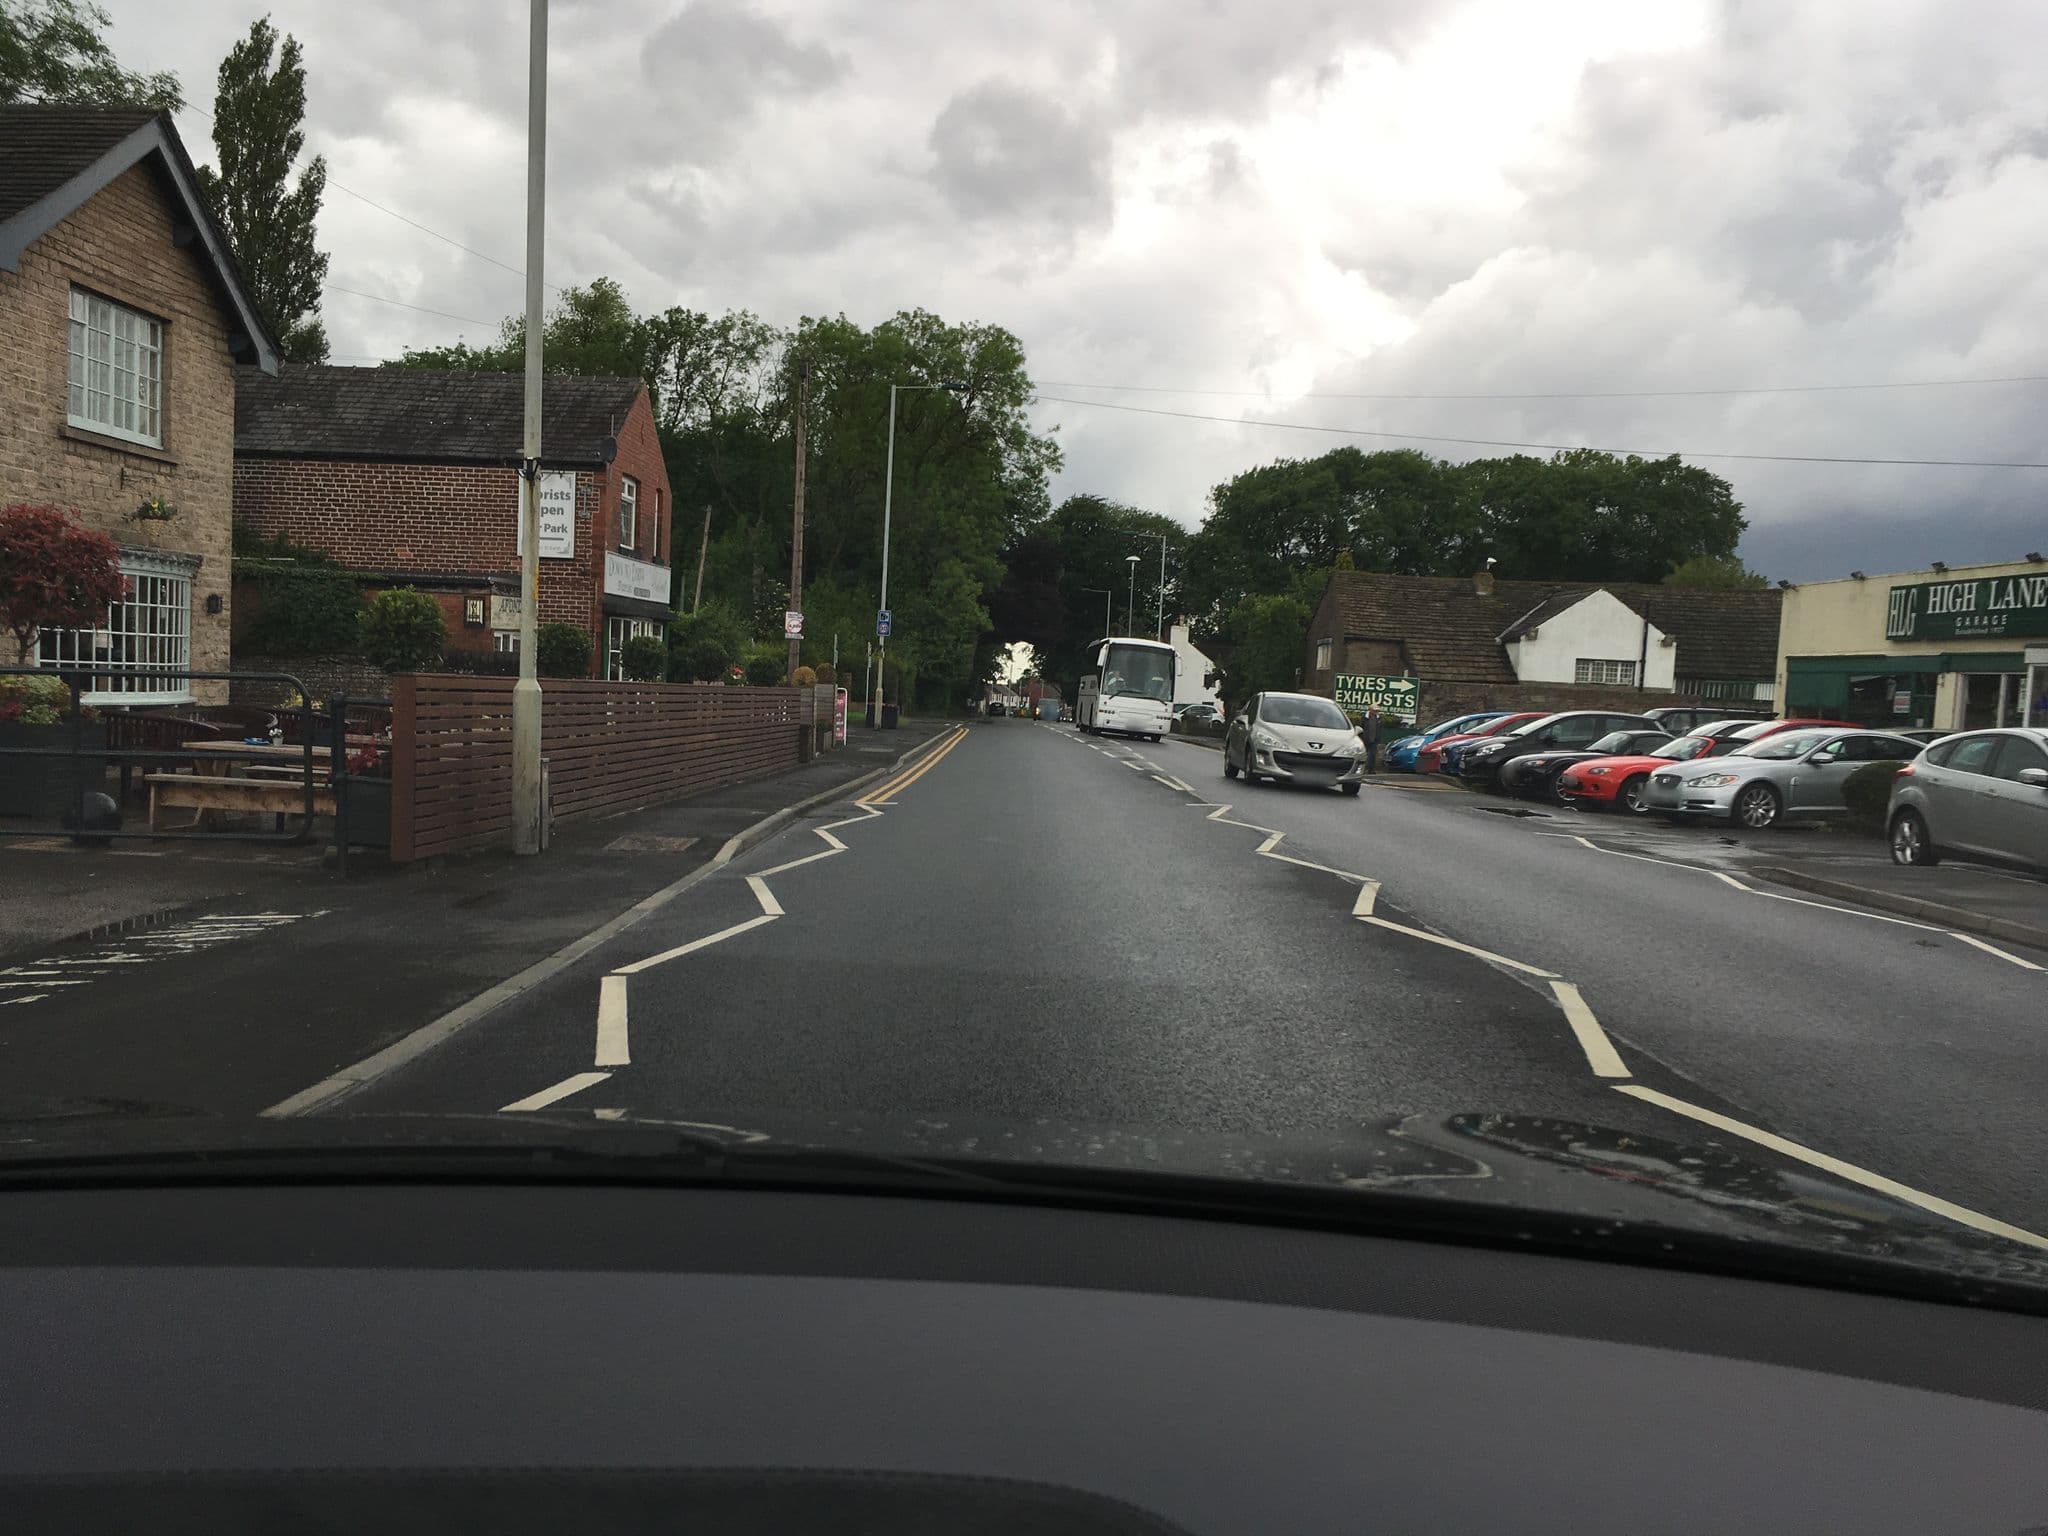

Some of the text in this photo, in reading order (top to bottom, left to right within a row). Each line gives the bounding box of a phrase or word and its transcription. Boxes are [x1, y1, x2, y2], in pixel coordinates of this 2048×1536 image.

[541, 506, 564, 517] pen
[544, 524, 568, 533] Park
[1927, 576, 2048, 614] HIGH LANE
[1887, 588, 1919, 637] HLG
[1955, 614, 2008, 627] GARAGE
[1336, 675, 1386, 691] TYRES
[1335, 690, 1415, 708] EXHAUSTS
